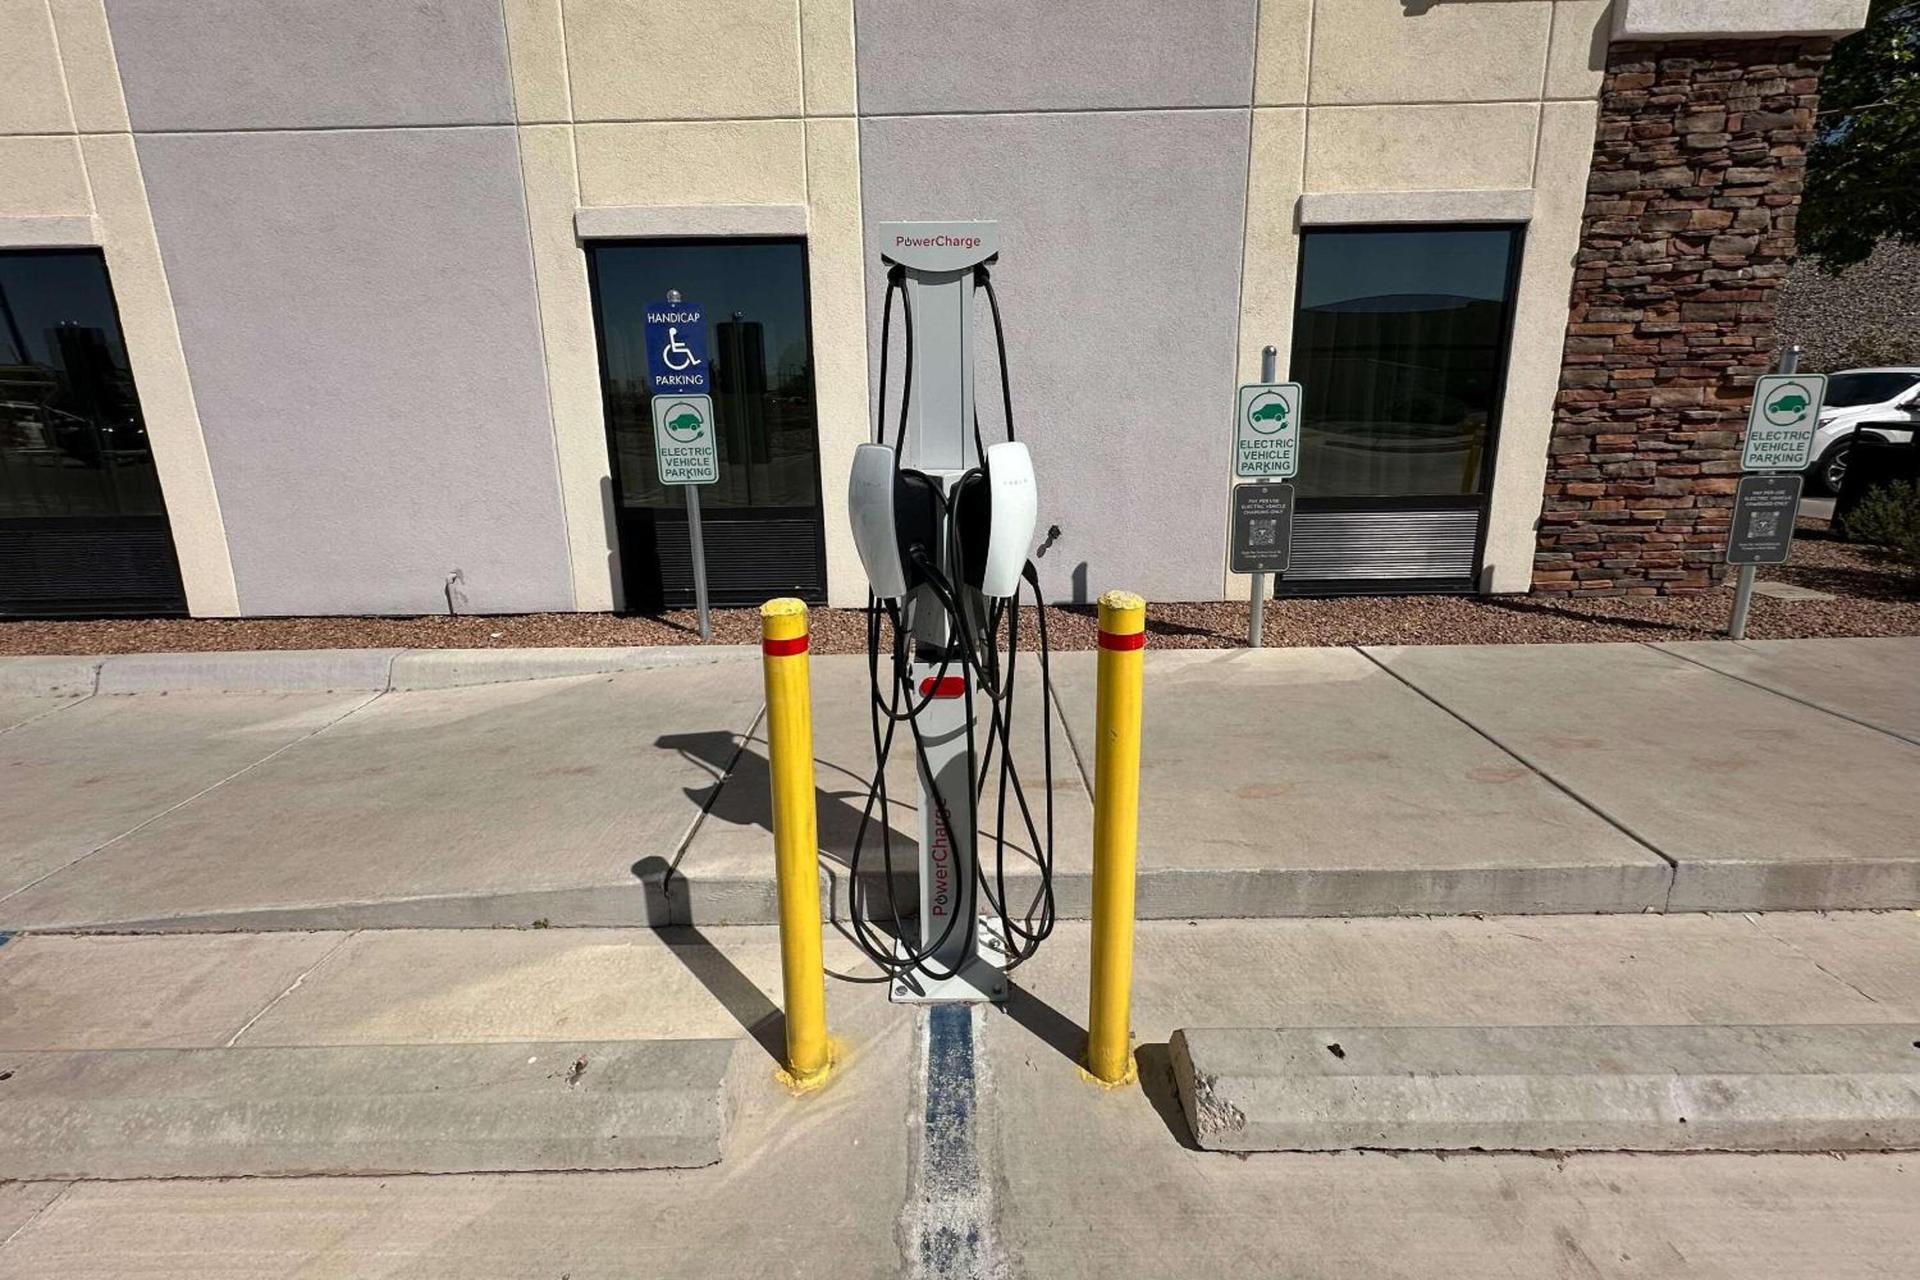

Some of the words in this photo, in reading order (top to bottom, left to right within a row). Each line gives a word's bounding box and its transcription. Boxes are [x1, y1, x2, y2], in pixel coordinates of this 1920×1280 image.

[896, 235, 981, 249] PowerCharge
[647, 312, 701, 323] HANDICAP
[656, 374, 704, 385] PARKING
[1751, 431, 1811, 441] ELECTRIC
[1240, 438, 1294, 449] ELECTRIC
[1753, 442, 1805, 452] VEHICLE
[661, 447, 712, 457] ELECTRIC
[1243, 450, 1291, 460] VEHICLE
[665, 457, 710, 467] VEHICLE
[1749, 453, 1803, 463] PARKING
[1241, 461, 1291, 471] PARKING
[665, 467, 712, 477] PARKING
[932, 799, 952, 916] PowerCharg
